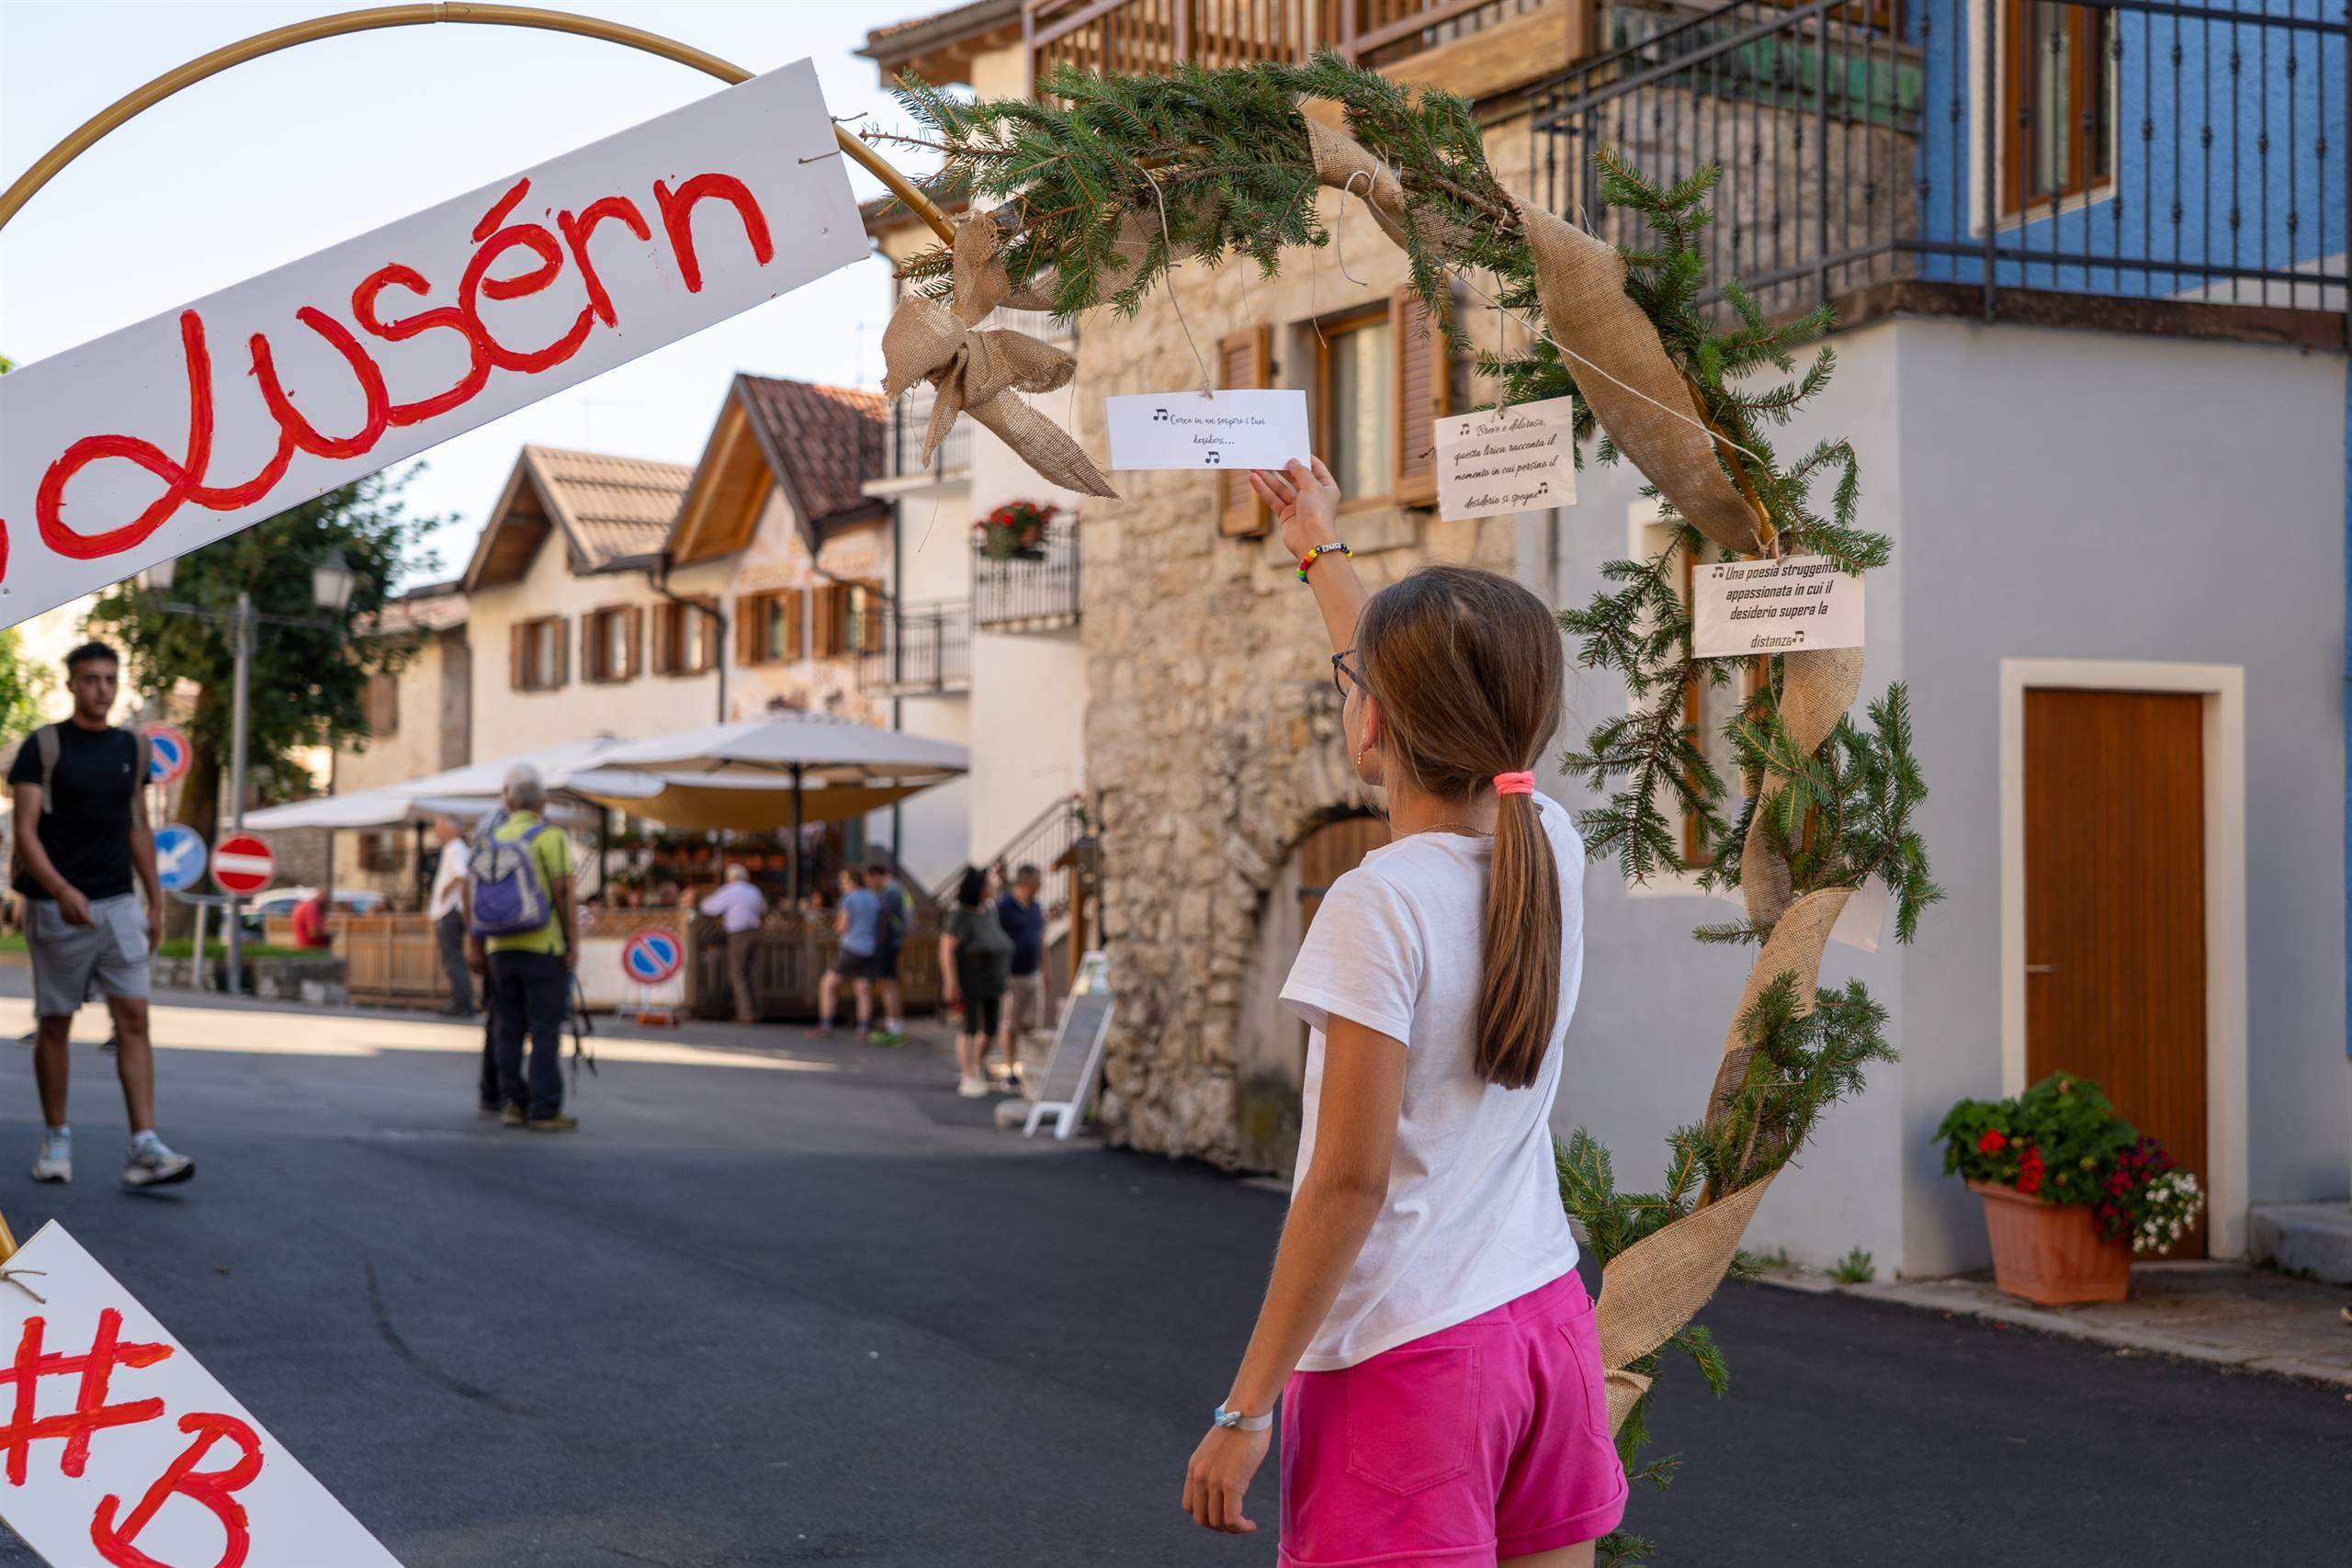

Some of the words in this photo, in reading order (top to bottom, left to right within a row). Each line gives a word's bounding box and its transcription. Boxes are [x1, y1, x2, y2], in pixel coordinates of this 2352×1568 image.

[36, 173, 774, 560] Lusérn
[1453, 448, 1481, 466] questa
[1483, 445, 1507, 456] lirica
[1509, 438, 1545, 452] racconta
[1546, 434, 1557, 446] il
[1454, 470, 1489, 481] momento
[1491, 467, 1499, 476] in
[1501, 465, 1515, 474] cui
[1515, 460, 1547, 478] persino
[1549, 455, 1559, 468] il
[1464, 494, 1499, 510] desiderio
[1501, 494, 1509, 505] si
[1510, 491, 1539, 507] spegne
[1725, 567, 1744, 581] Una
[1746, 566, 1779, 581] poesia
[1726, 585, 1792, 603] appassionata
[1794, 584, 1804, 596] in
[1806, 582, 1824, 595] cui
[1825, 580, 1832, 593] il
[1730, 606, 1777, 620] desiderio
[1779, 605, 1815, 620] supera
[1817, 601, 1828, 615] la
[1750, 633, 1792, 649] distanza
